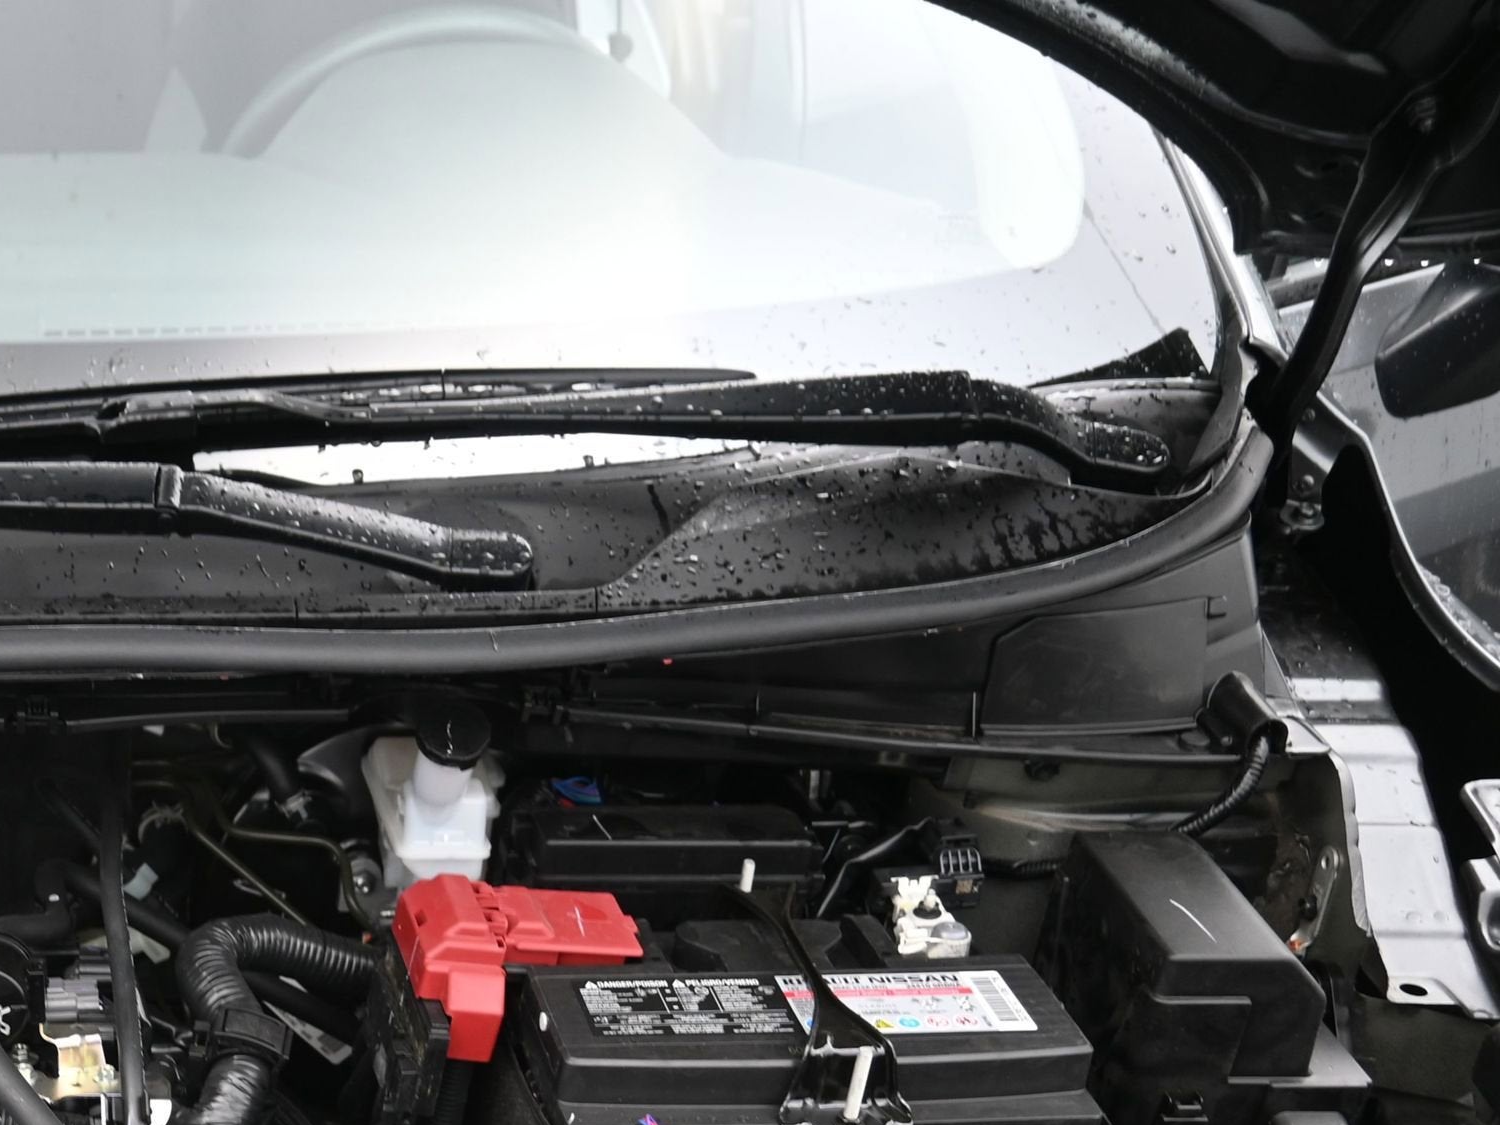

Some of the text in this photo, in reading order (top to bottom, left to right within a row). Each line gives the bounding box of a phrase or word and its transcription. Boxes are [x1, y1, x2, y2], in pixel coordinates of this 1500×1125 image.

[684, 978, 759, 987] PELIGRO/VENENO
[868, 975, 958, 983] NISSAN
[597, 980, 668, 988] DANGER/POISON
